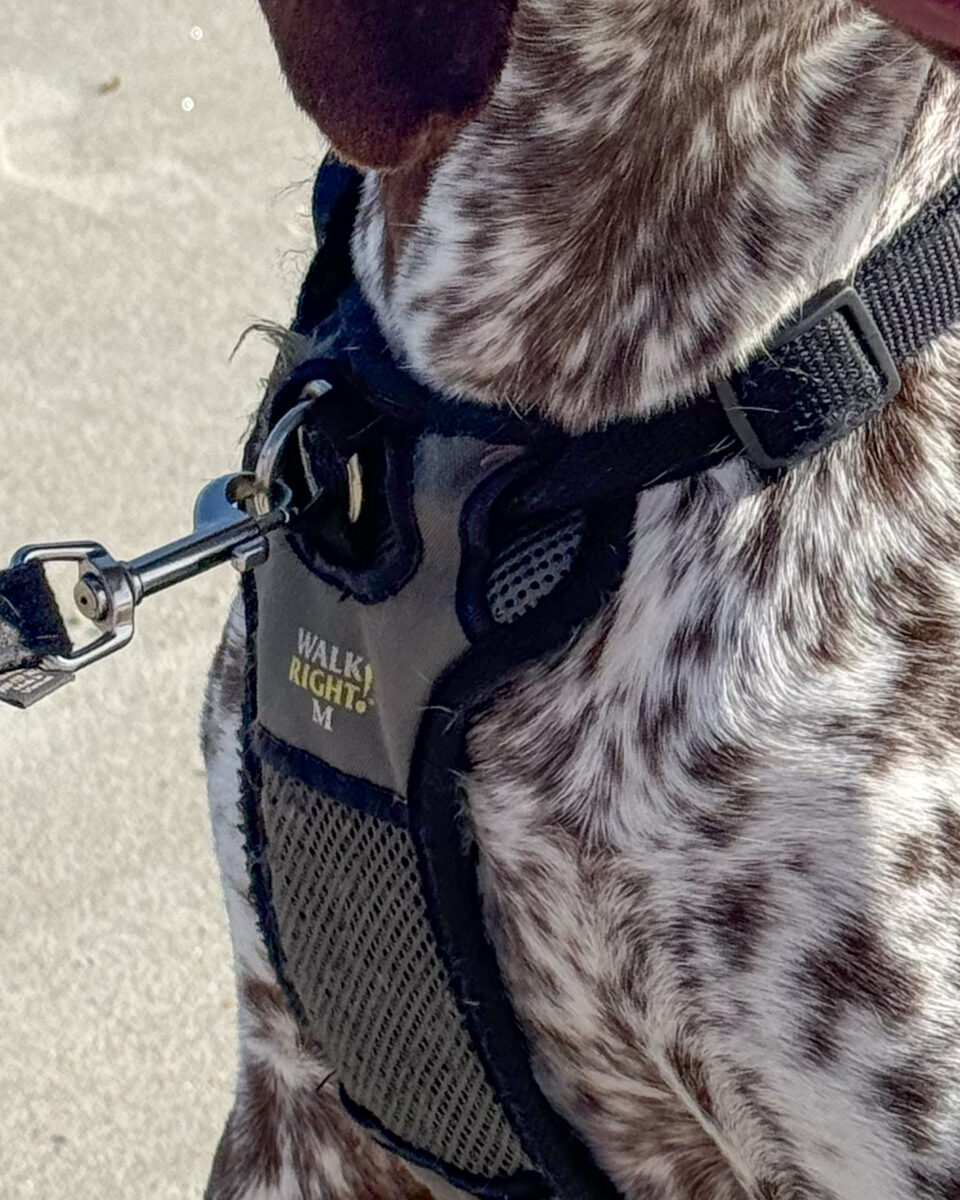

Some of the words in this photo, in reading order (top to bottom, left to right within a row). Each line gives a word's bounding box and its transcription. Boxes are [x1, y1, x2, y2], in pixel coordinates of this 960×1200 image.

[298, 627, 363, 682] WALK
[288, 655, 373, 714] RIGHT!
[312, 697, 333, 732] M
